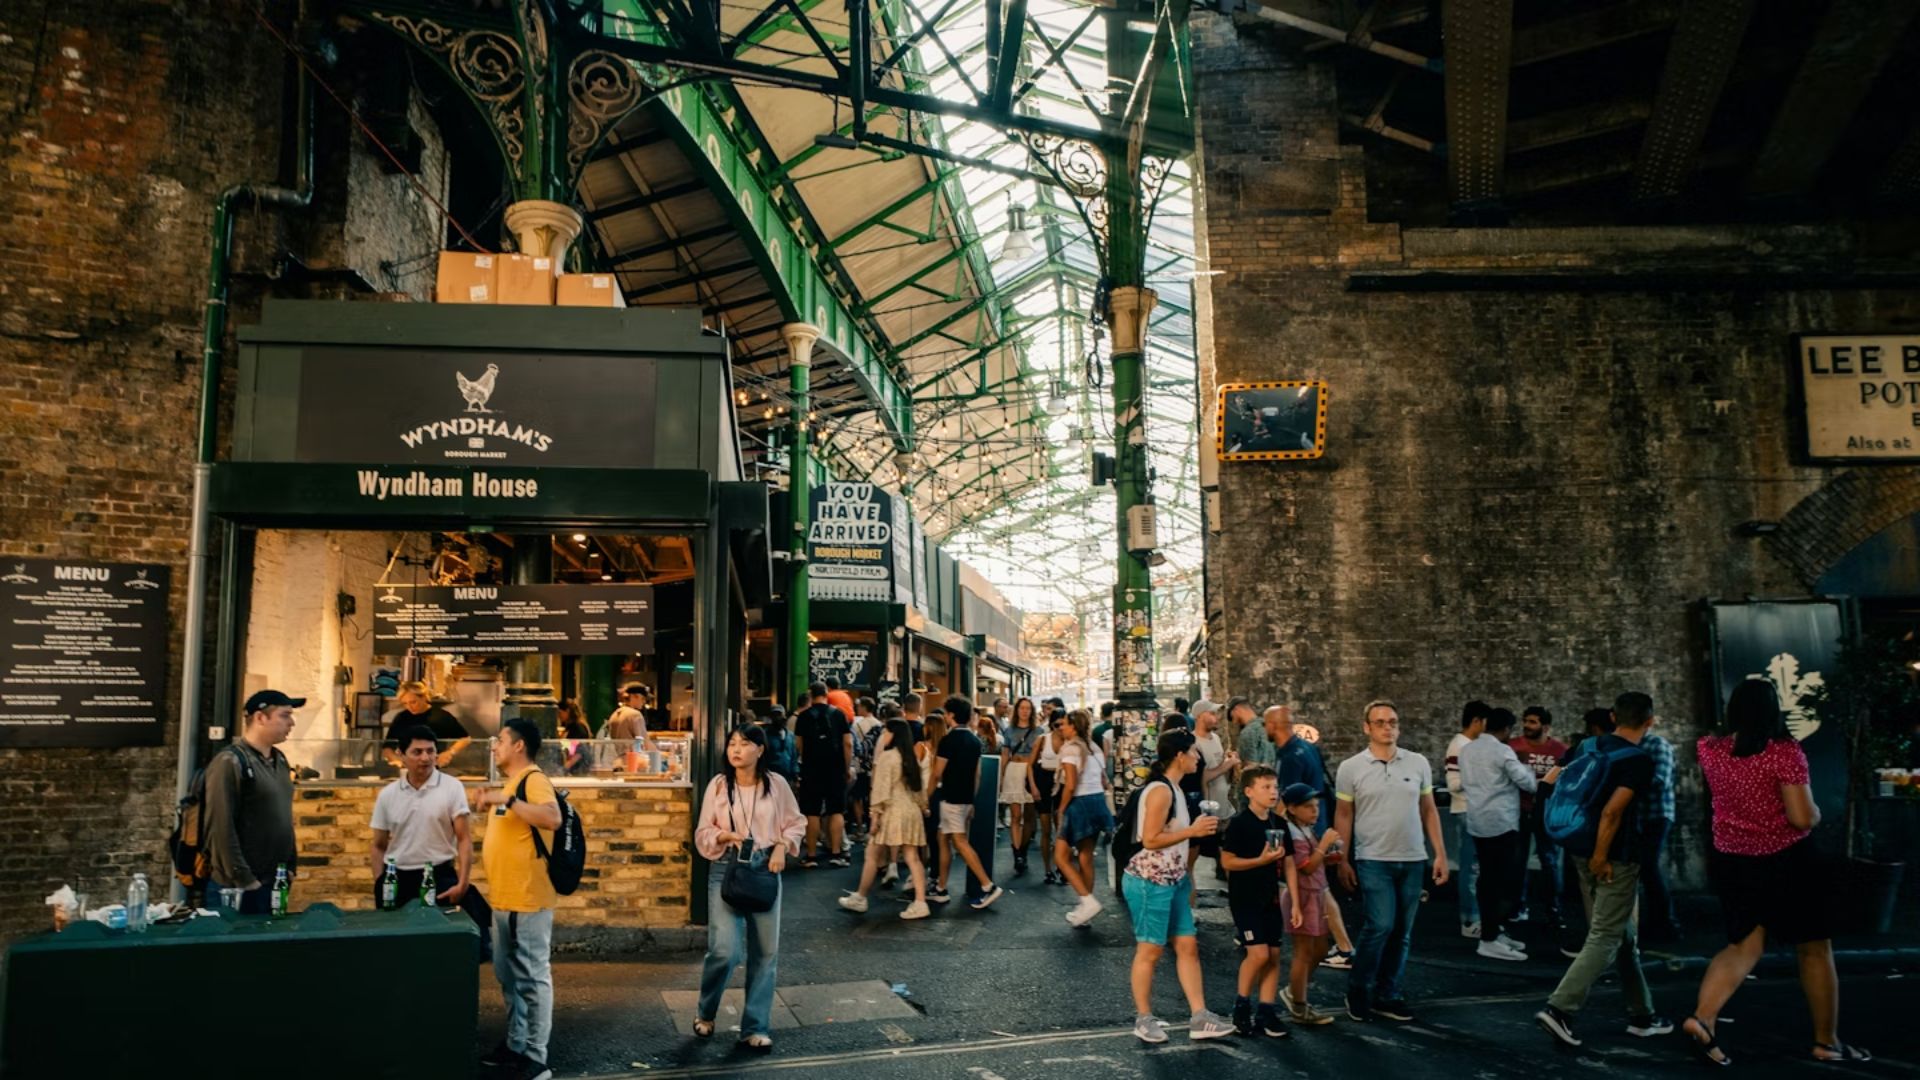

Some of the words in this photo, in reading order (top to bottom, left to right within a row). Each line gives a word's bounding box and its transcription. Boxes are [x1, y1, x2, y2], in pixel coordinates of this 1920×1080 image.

[1808, 346, 1883, 374] LEE
[1859, 381, 1920, 405] POT
[400, 417, 553, 452] WYNDHAM'S
[1846, 435, 1885, 449] Also
[1892, 436, 1912, 449] at
[357, 470, 463, 500] Wyndham
[472, 472, 538, 498] House
[828, 484, 871, 501] YOU
[821, 504, 877, 521] HAVE
[811, 523, 888, 541] ARRIVED
[54, 565, 110, 581] MENU
[454, 587, 498, 600] MENU
